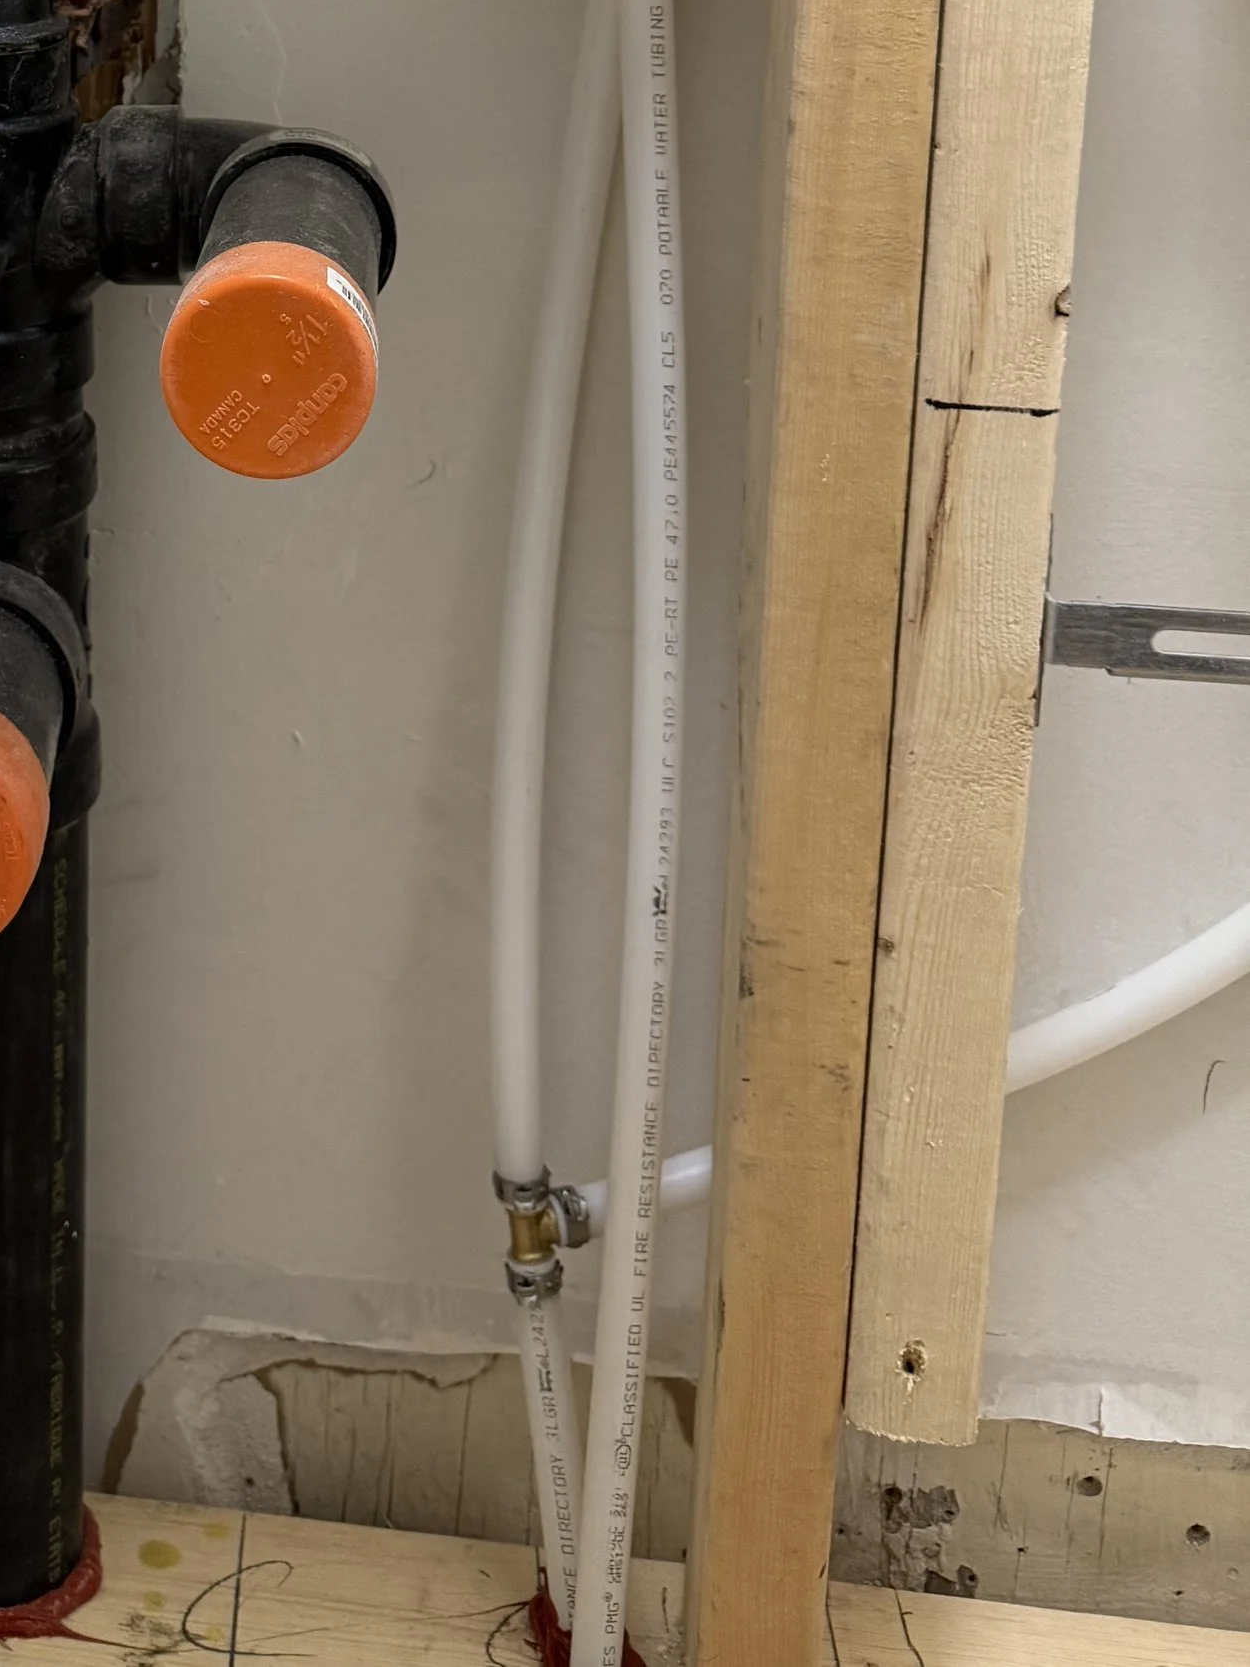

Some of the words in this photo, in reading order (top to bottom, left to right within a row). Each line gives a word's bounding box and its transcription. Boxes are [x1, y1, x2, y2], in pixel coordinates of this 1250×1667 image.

[650, 5, 666, 78] TUBING
[199, 389, 243, 434] CANADA
[210, 403, 261, 451] TC315
[267, 372, 348, 457] canplas
[664, 557, 679, 581] PE
[664, 597, 678, 657] PE-RT
[637, 1101, 659, 1218] RESISTANCE
[633, 1231, 650, 1277] FIRE
[630, 1290, 646, 1312] UL
[620, 1324, 642, 1438] CLASSIFIED
[549, 1453, 575, 1555] DIRECTORY
